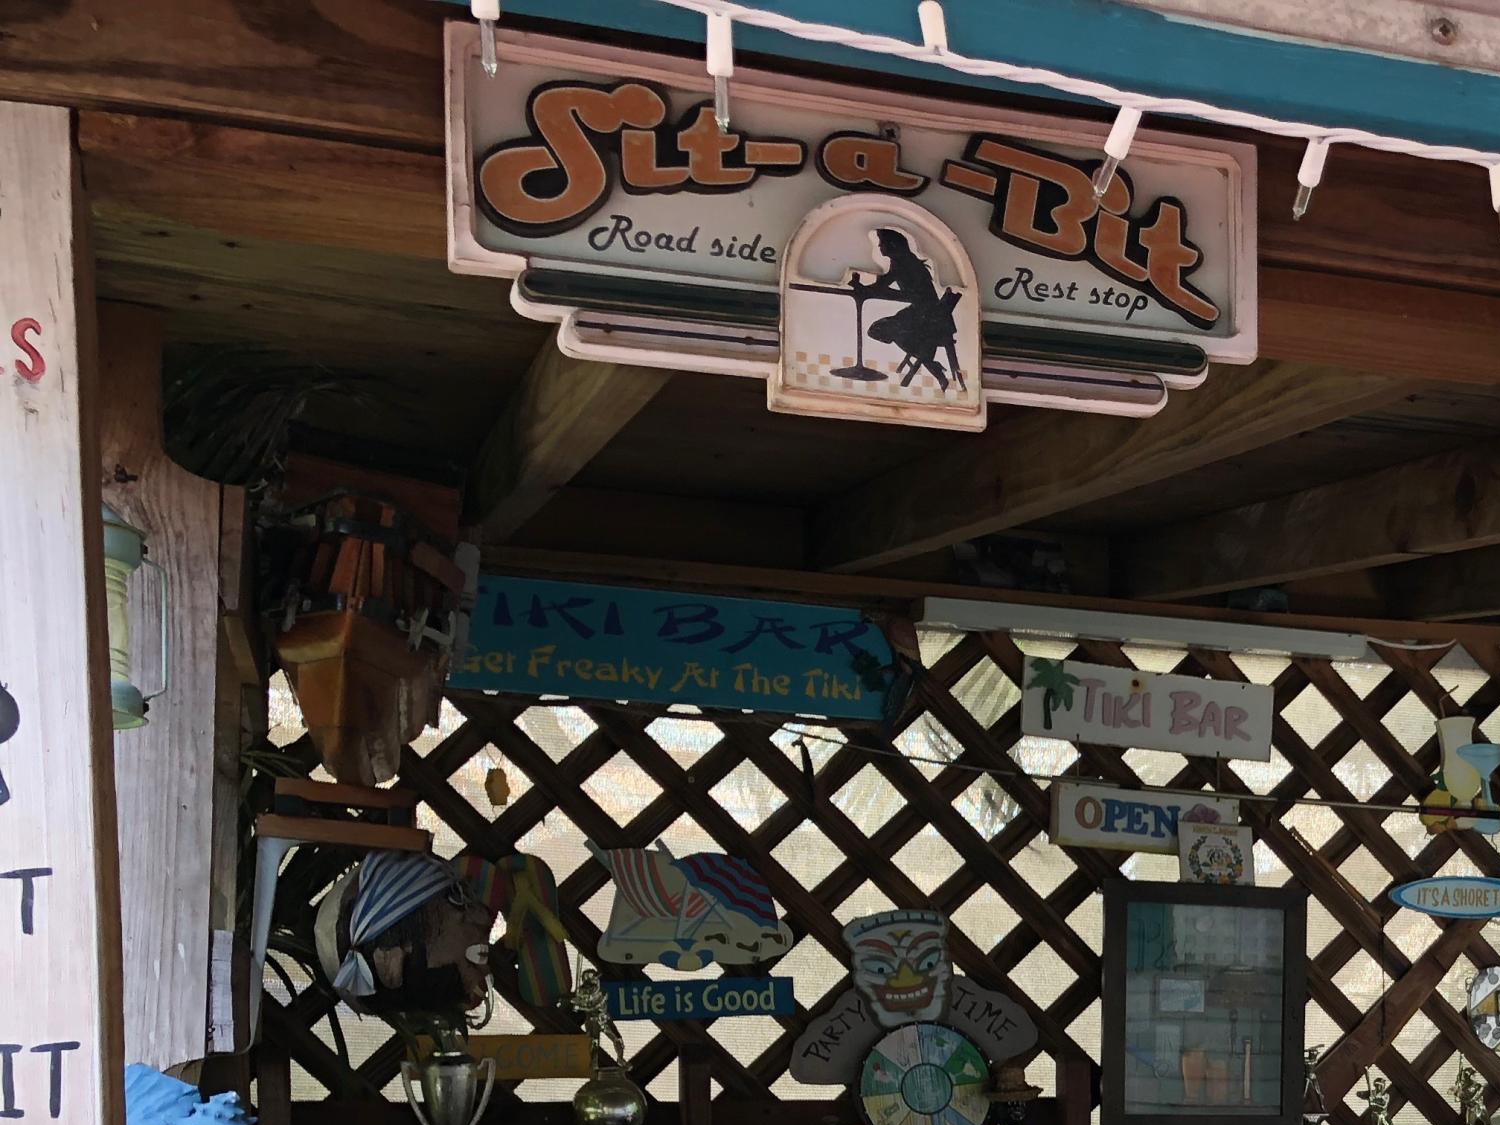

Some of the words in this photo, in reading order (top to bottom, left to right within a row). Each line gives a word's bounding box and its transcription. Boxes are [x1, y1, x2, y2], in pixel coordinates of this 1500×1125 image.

[588, 214, 700, 253] Road
[709, 233, 777, 263] side
[994, 267, 1079, 302] Rest
[1088, 286, 1149, 321] stop
[478, 586, 625, 640] IKI
[652, 602, 878, 657] BAR
[526, 645, 664, 690] Freaky
[669, 661, 718, 694] At
[731, 663, 791, 695] The
[802, 668, 862, 702] Tiki
[1079, 677, 1151, 730] TIKI
[1168, 690, 1253, 743] BAR
[1073, 796, 1181, 838] OPEN
[618, 985, 667, 1016] Life
[674, 985, 695, 1014] is
[701, 981, 777, 1014] Good
[801, 998, 869, 1063] PARTY
[951, 986, 1019, 1042] TIME
